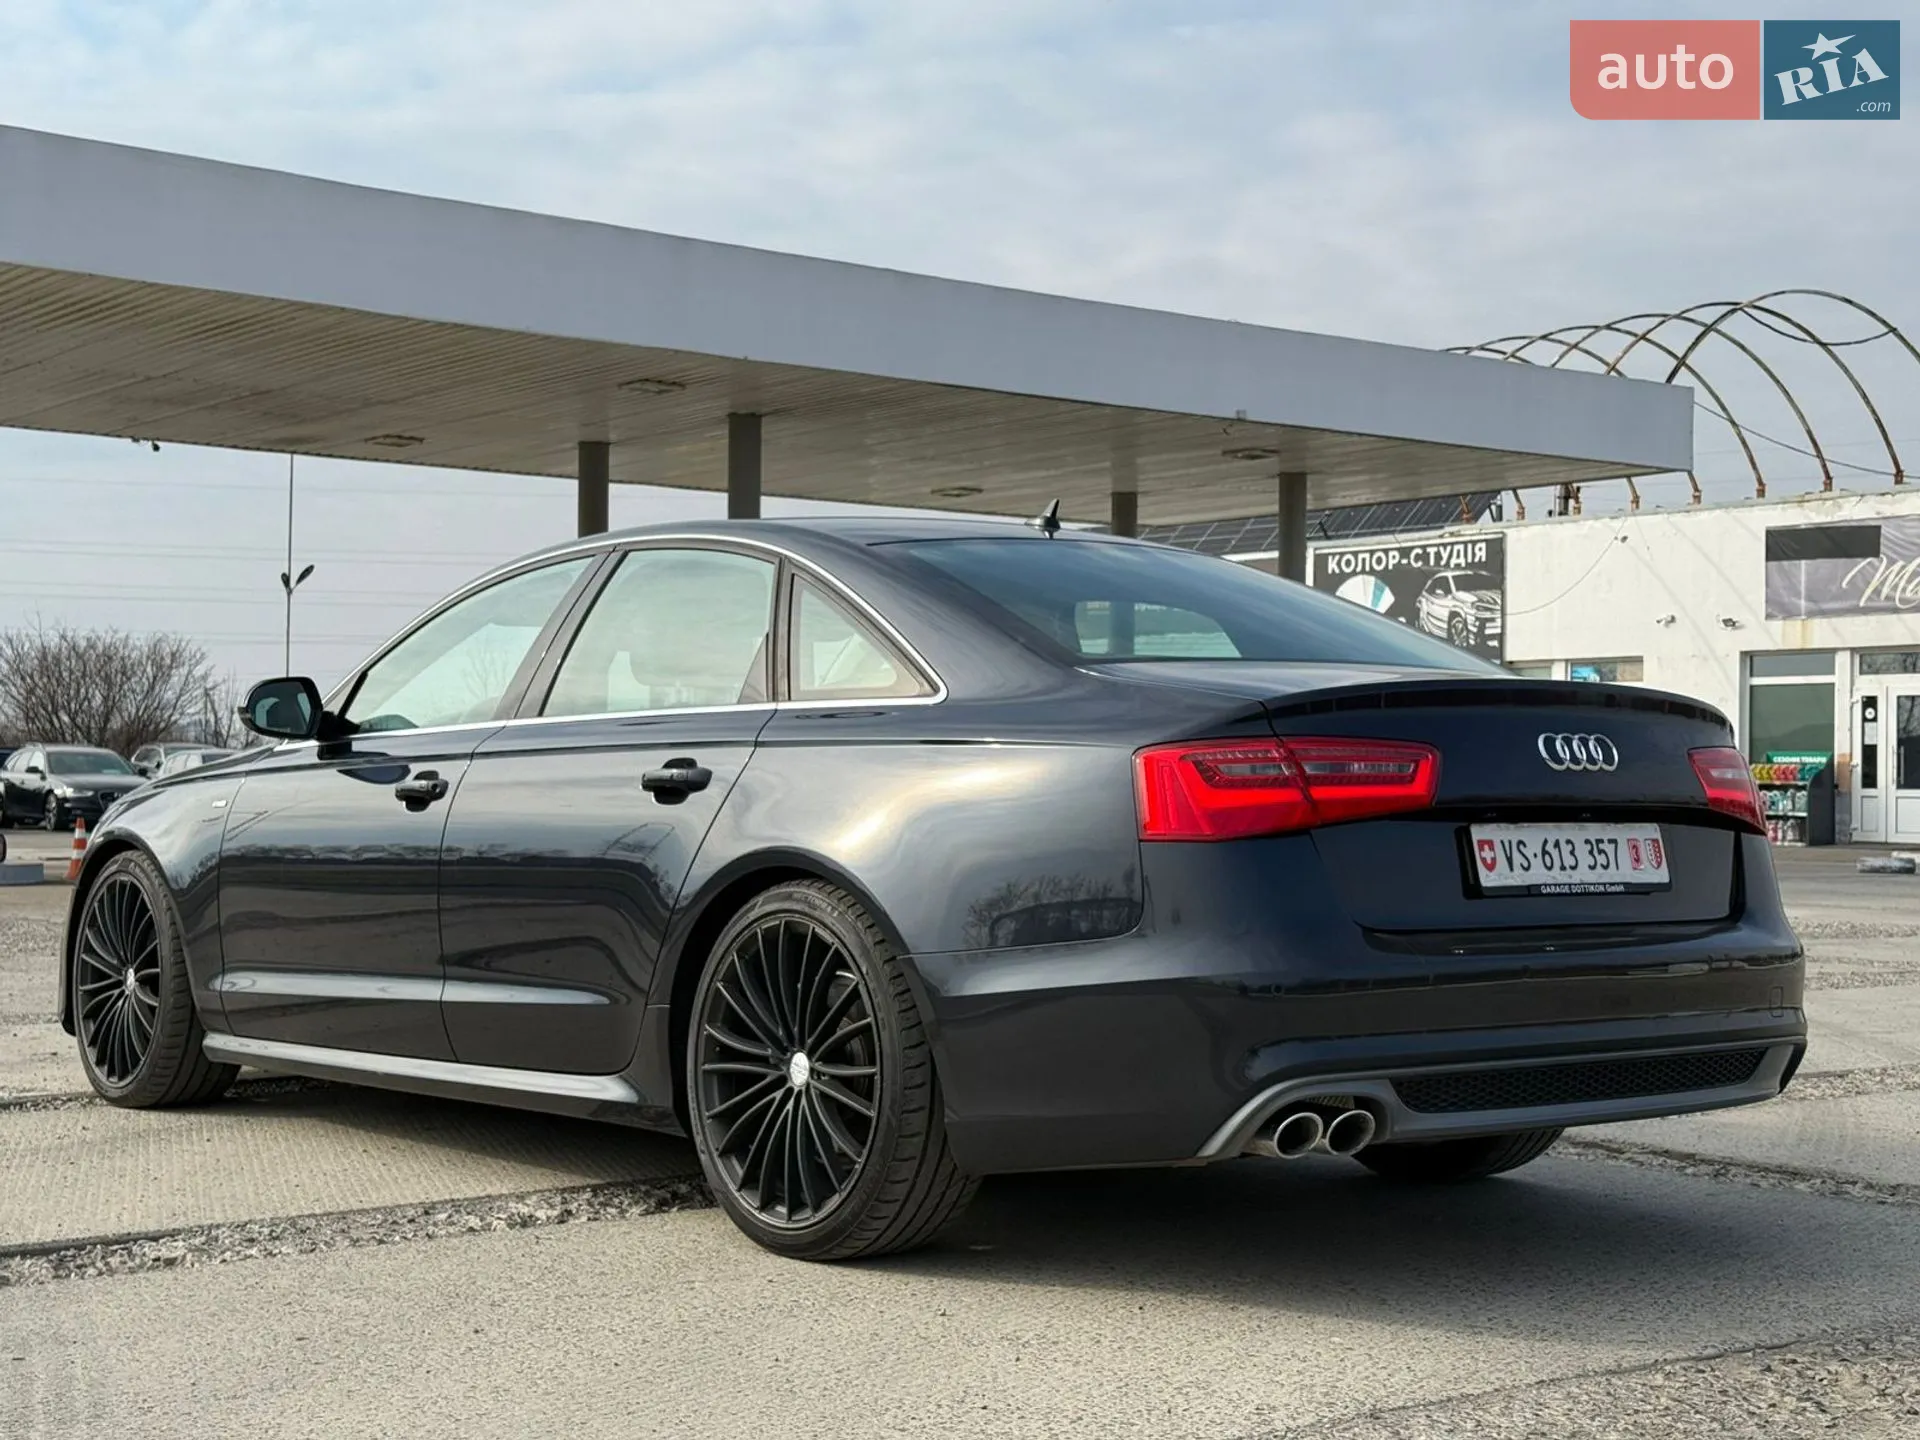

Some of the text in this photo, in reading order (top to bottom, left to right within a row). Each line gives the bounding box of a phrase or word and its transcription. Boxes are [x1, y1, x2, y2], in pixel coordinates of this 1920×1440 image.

[1327, 541, 1488, 575] КОЛОР-СТУДІЯ
[1583, 837, 1620, 871] 357
[1540, 884, 1570, 894] GARAGE
